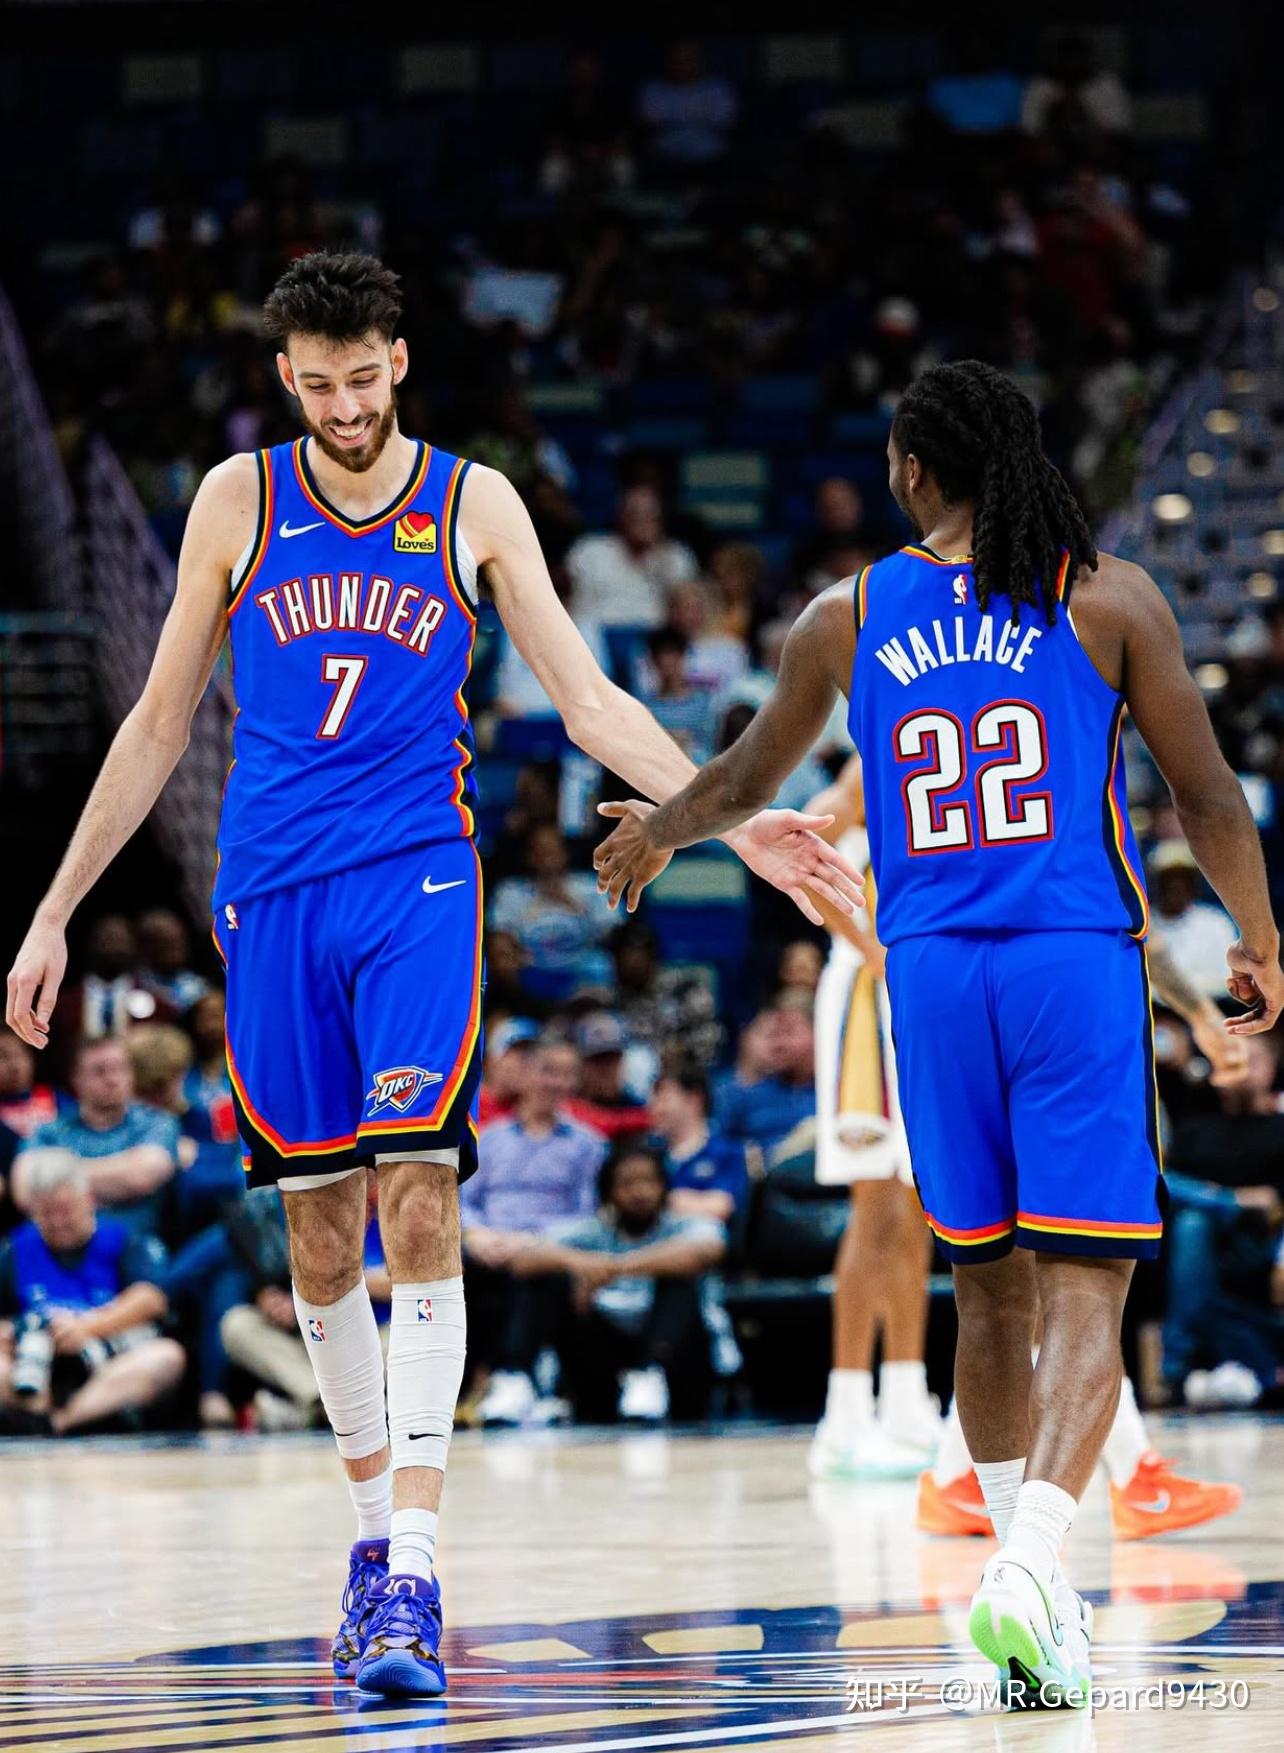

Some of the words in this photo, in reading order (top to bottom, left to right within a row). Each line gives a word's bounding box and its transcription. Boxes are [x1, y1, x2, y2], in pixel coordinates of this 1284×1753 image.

[255, 573, 448, 658] THUNDER
[875, 615, 1042, 686] WALLACE
[316, 654, 369, 740] 7
[893, 699, 1054, 857] 22
[378, 1074, 414, 1103] OKC
